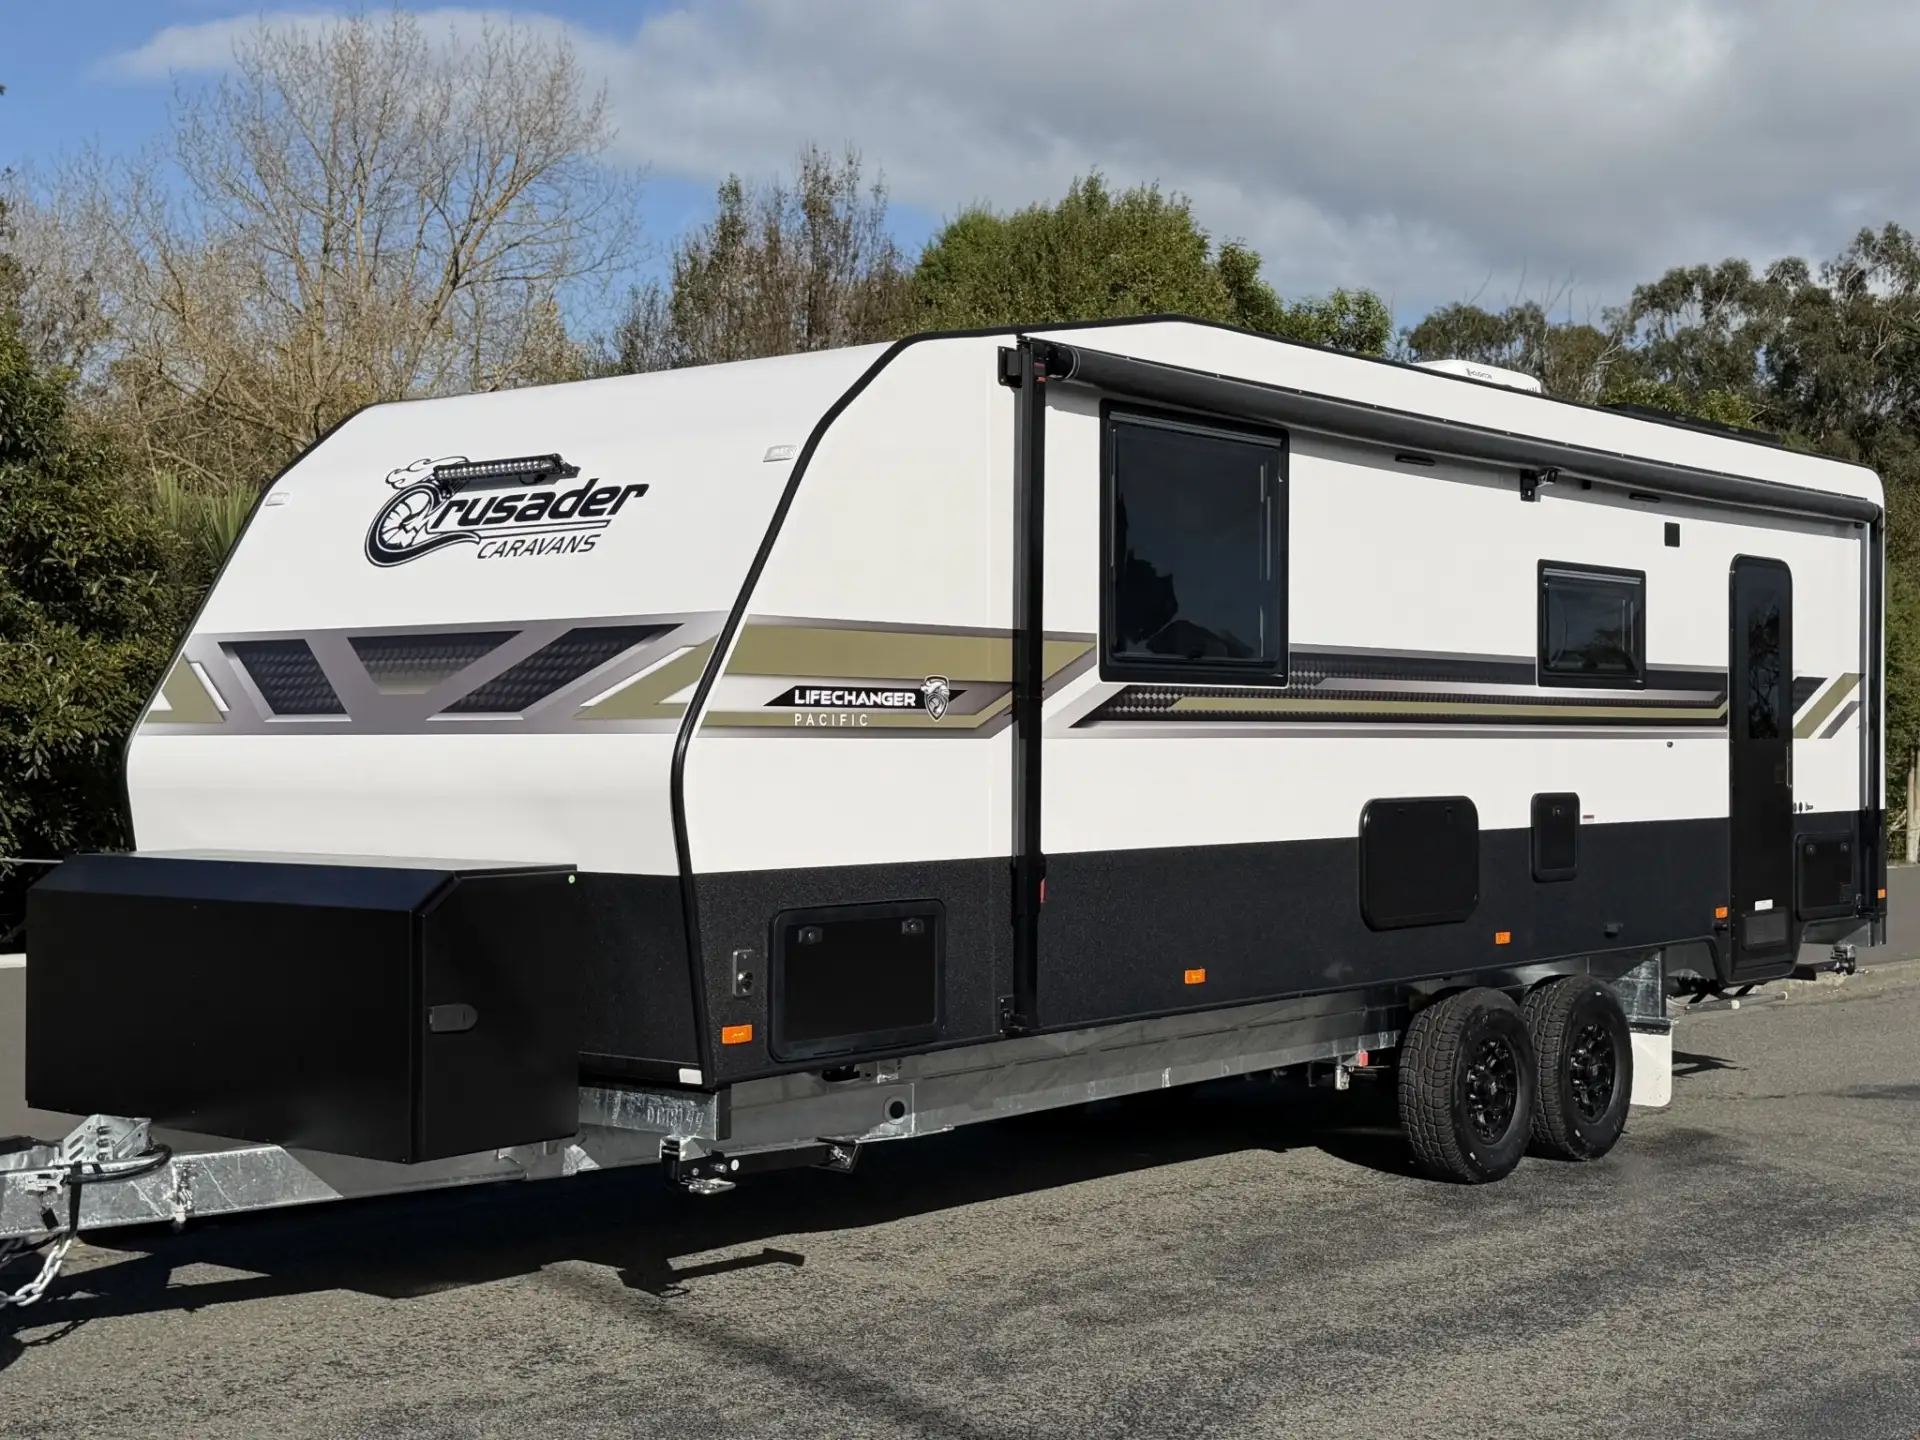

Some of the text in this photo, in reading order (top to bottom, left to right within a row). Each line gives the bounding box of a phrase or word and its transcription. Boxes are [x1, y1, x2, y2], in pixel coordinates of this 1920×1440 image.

[364, 477, 650, 568] Crusader
[477, 533, 602, 560] CARAVANS
[794, 689, 916, 706] LIFECHANGER
[794, 713, 868, 727] PACIFIC
